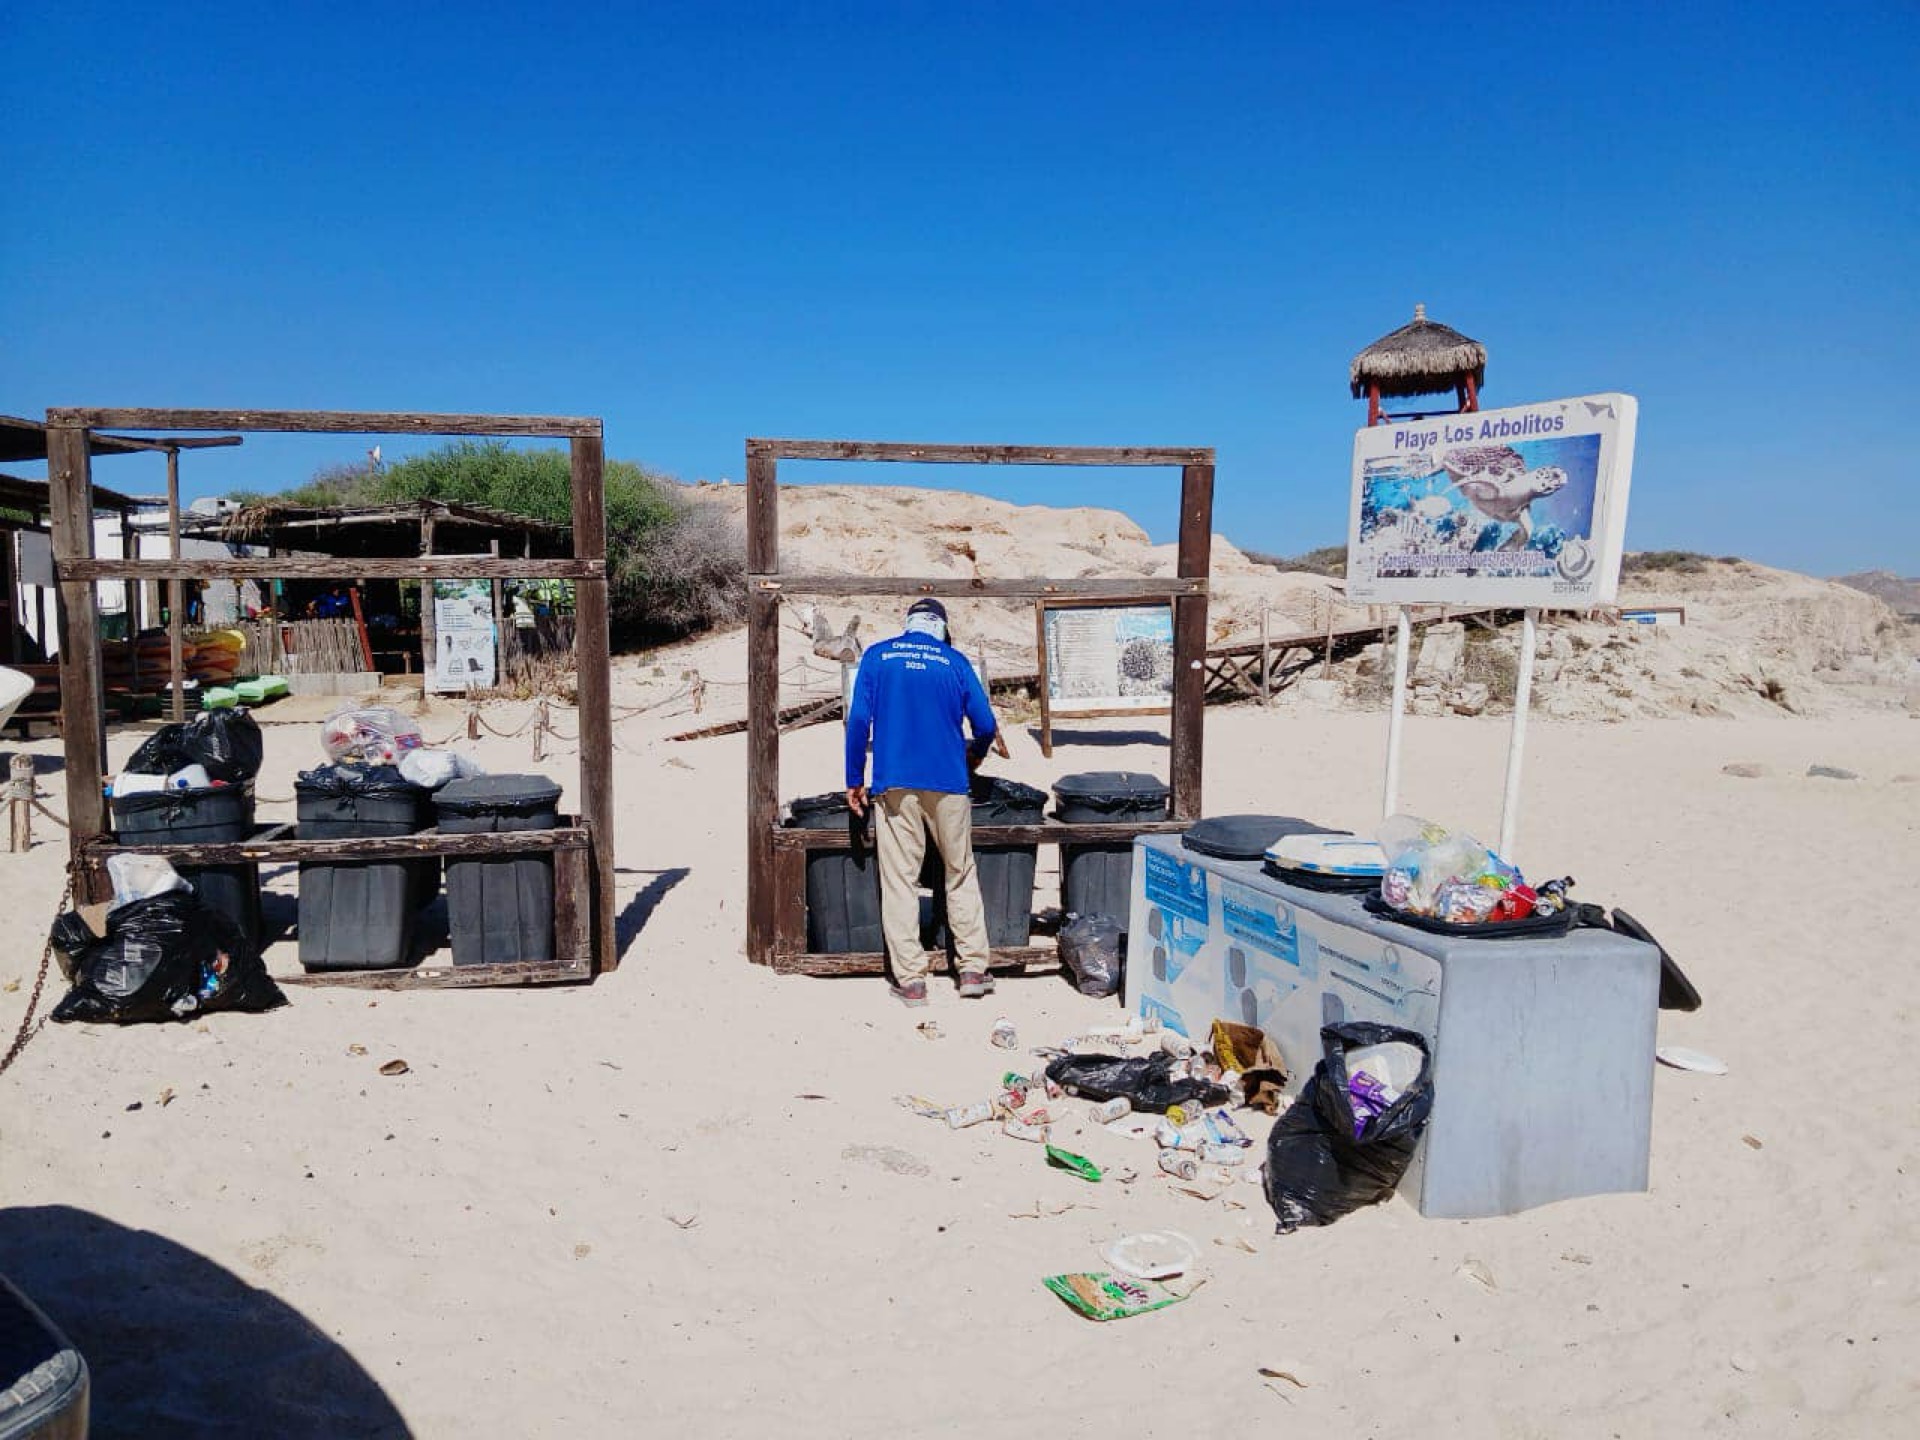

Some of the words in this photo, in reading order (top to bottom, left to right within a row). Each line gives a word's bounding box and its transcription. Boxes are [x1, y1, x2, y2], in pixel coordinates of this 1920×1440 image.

[1394, 430, 1438, 451] Playa
[1444, 424, 1474, 443] Los
[1479, 414, 1564, 439] Arbolitos
